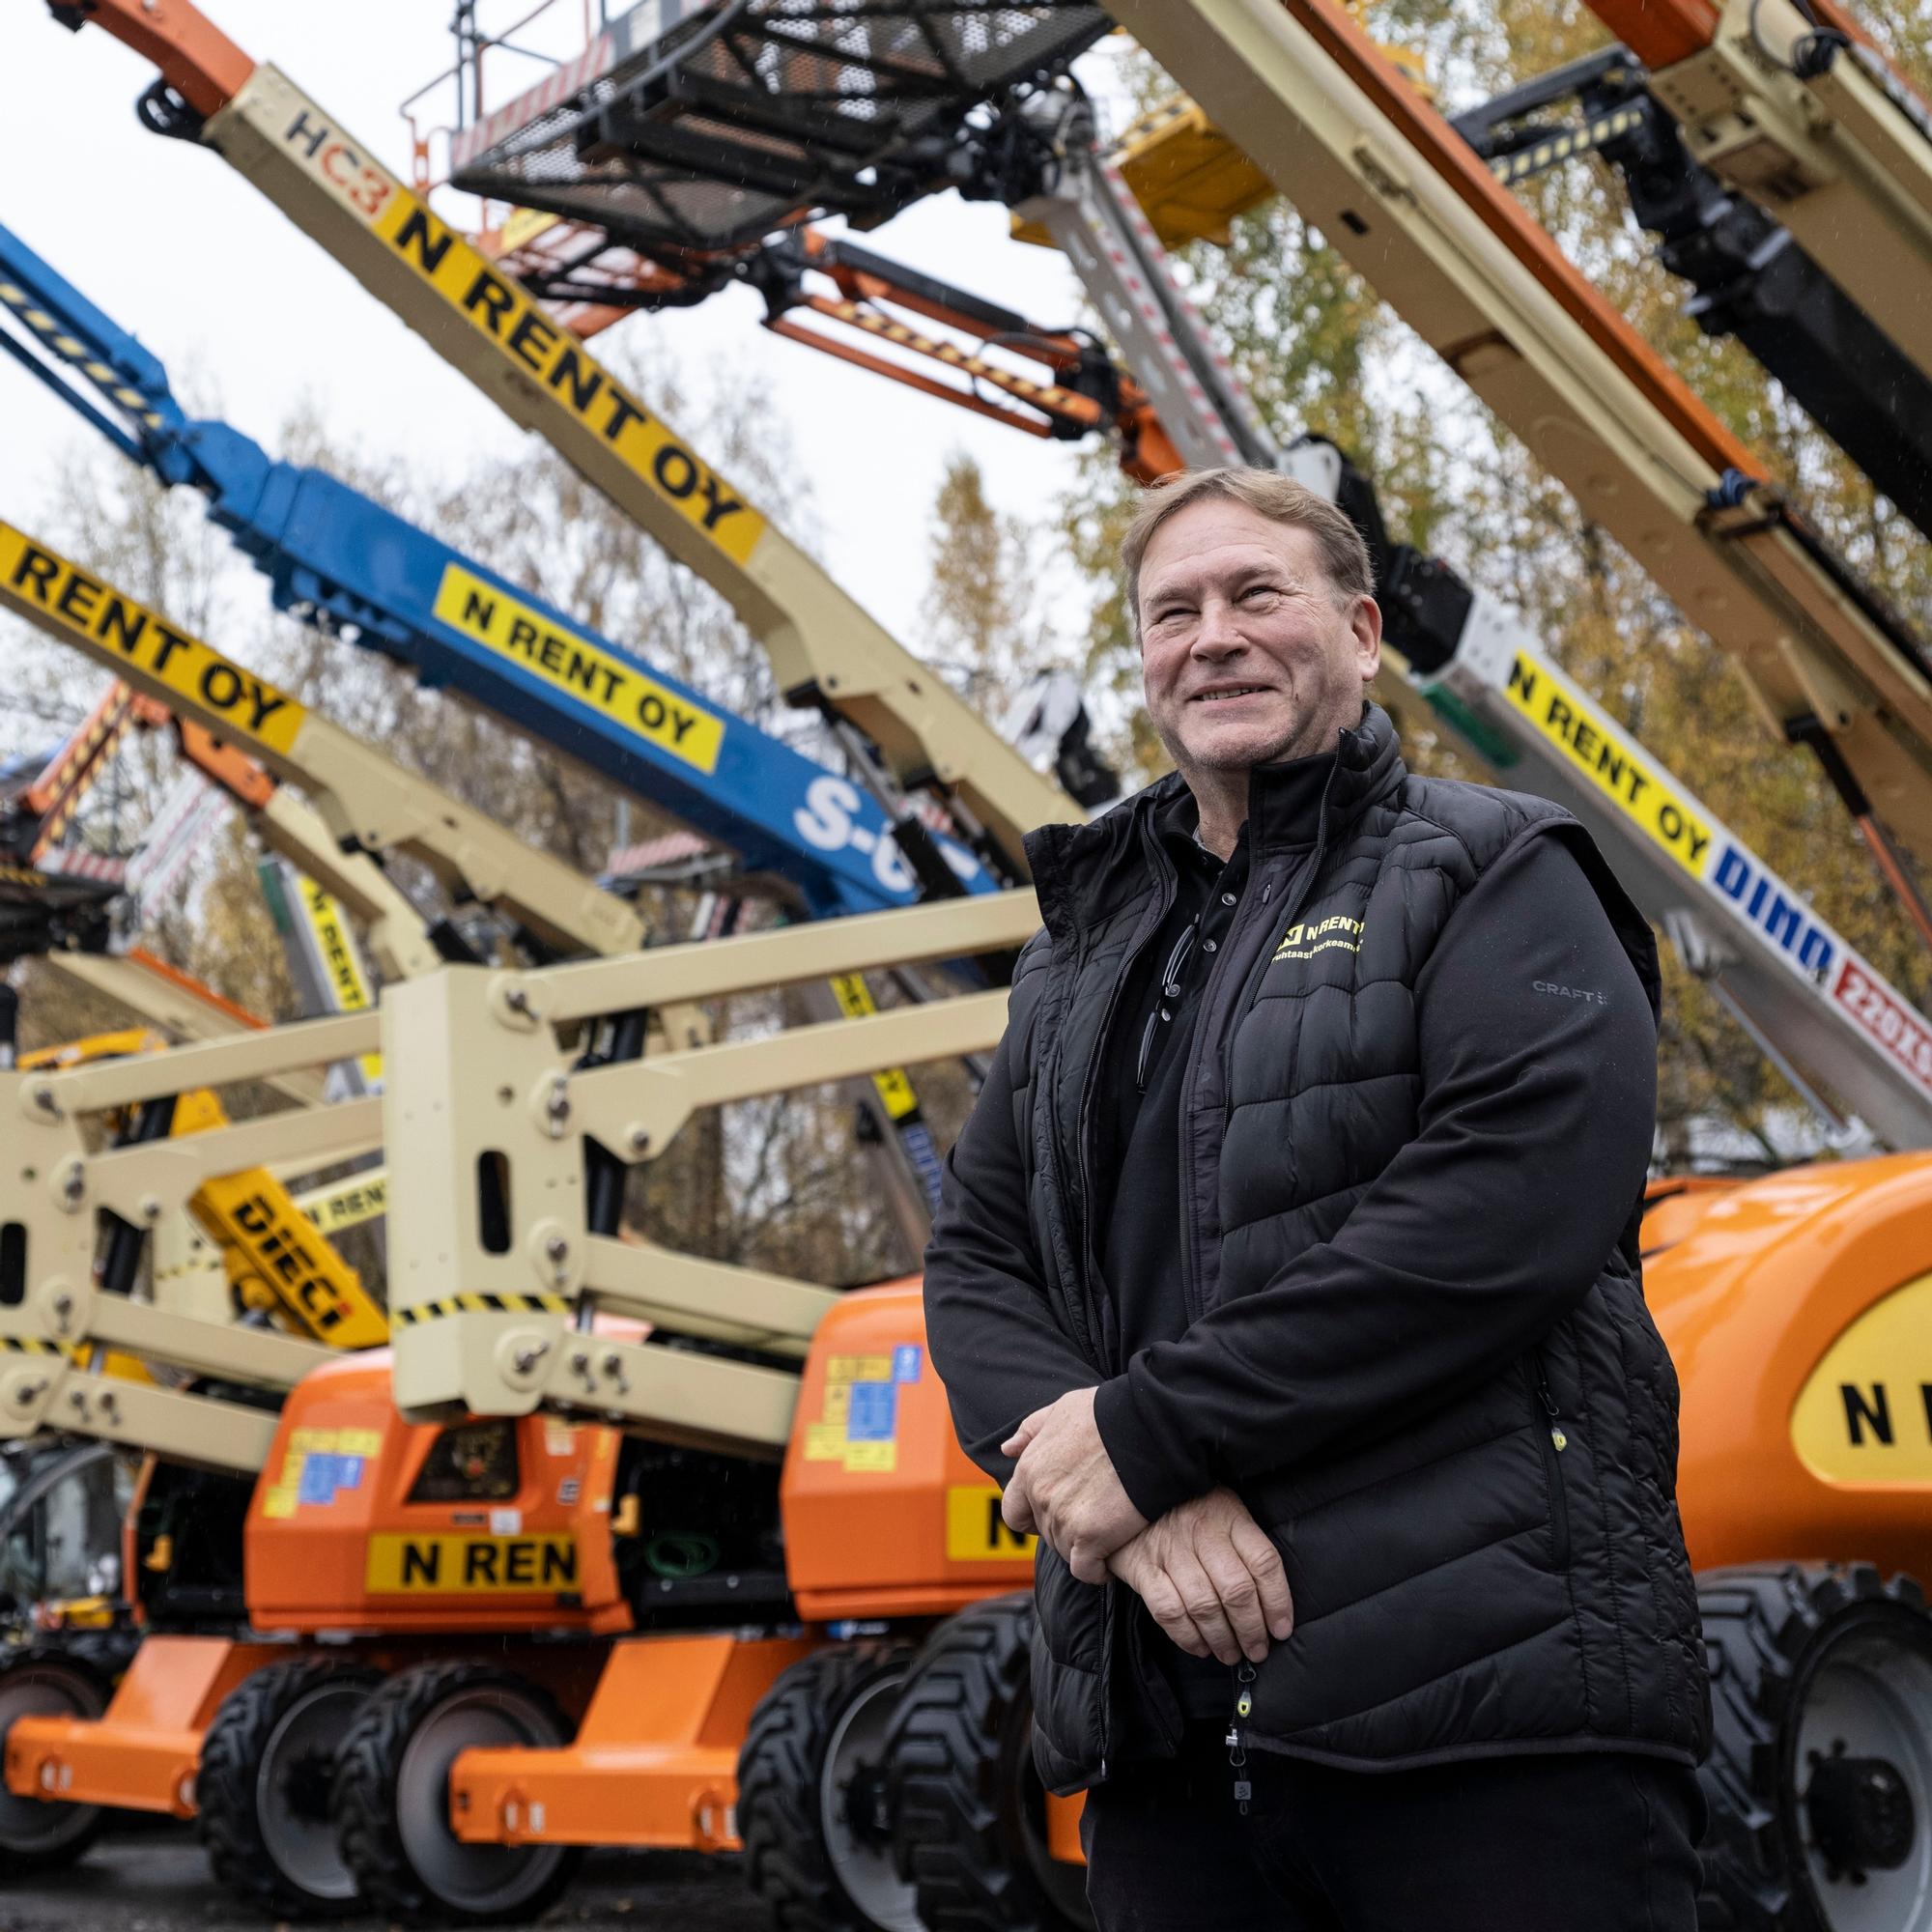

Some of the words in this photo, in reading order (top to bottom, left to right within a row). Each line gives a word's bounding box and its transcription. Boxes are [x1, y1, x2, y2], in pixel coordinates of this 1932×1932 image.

[285, 109, 391, 218] HC3
[395, 207, 454, 276] N
[461, 270, 646, 441] RENT
[651, 446, 744, 531] OY
[11, 545, 190, 672] RENT
[200, 662, 287, 730] OY
[463, 590, 497, 630] N
[508, 613, 626, 702] RENT
[637, 692, 697, 745] OY
[1508, 660, 1536, 703] N
[1548, 695, 1652, 803] RENT
[1658, 803, 1710, 861] OY
[1713, 843, 1838, 972] DINO
[1532, 980, 1595, 1002] CRAFT
[1839, 1382, 1895, 1446] N
[402, 1542, 440, 1584] N
[464, 1542, 576, 1584] REN
